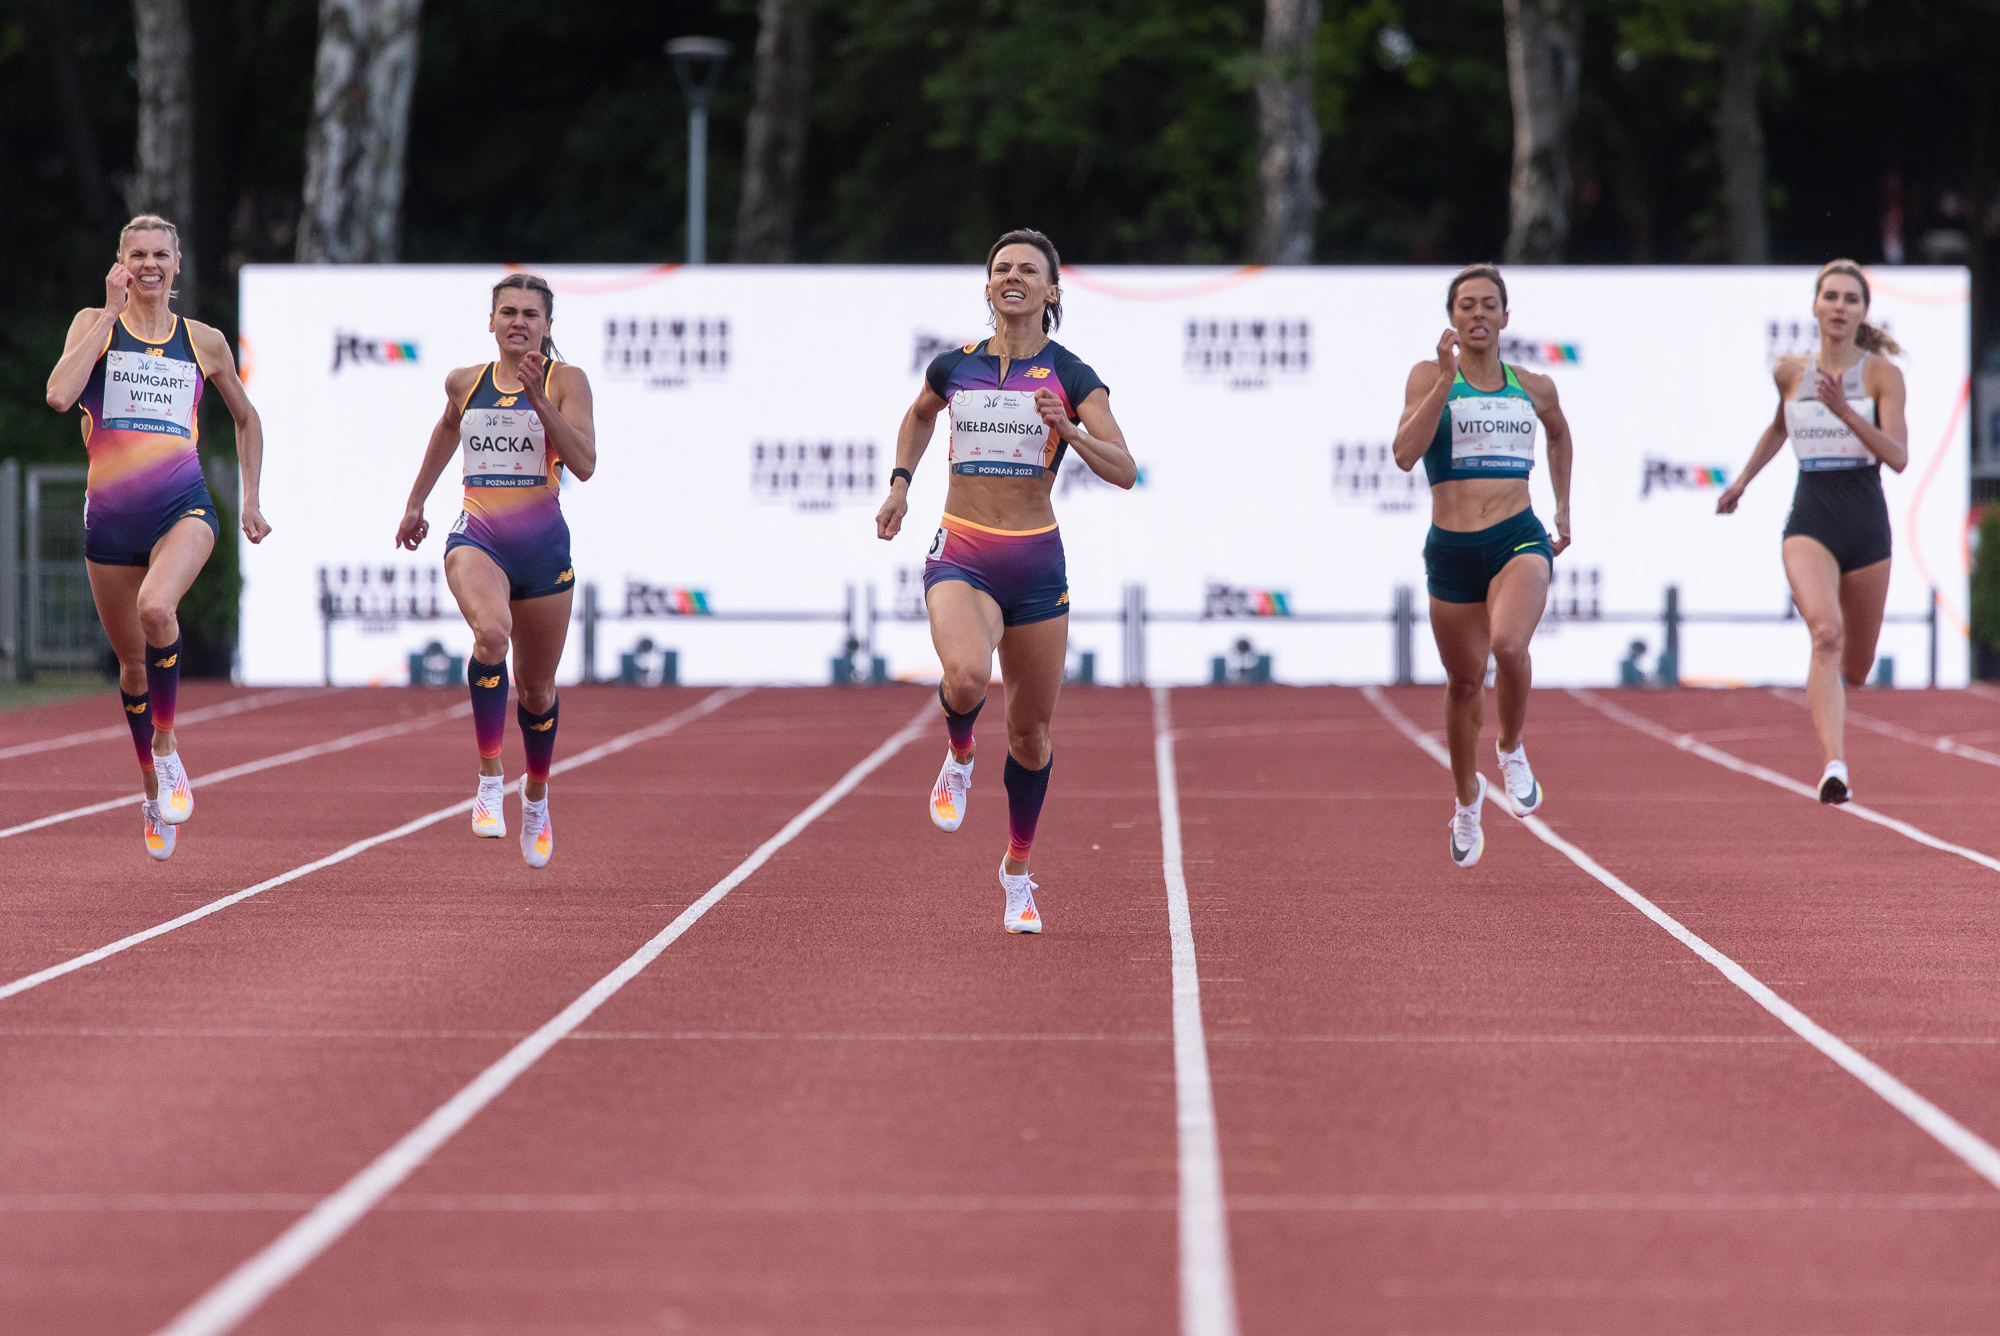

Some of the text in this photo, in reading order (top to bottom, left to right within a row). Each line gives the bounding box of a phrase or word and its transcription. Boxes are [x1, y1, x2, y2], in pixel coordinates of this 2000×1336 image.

[113, 371, 189, 389] BAUMGART-
[130, 390, 172, 405] WITAN
[133, 422, 165, 432] POZNAŃ
[166, 425, 182, 435] 2022
[956, 420, 1043, 436] KIEŁBASIŃSKA
[1458, 420, 1532, 434] VITORINO
[469, 435, 535, 453] GACKA
[979, 466, 1013, 476] POZNAŃ
[1015, 467, 1033, 476] 2022
[485, 478, 516, 487] POZNAŃ
[517, 478, 535, 486] 2022
